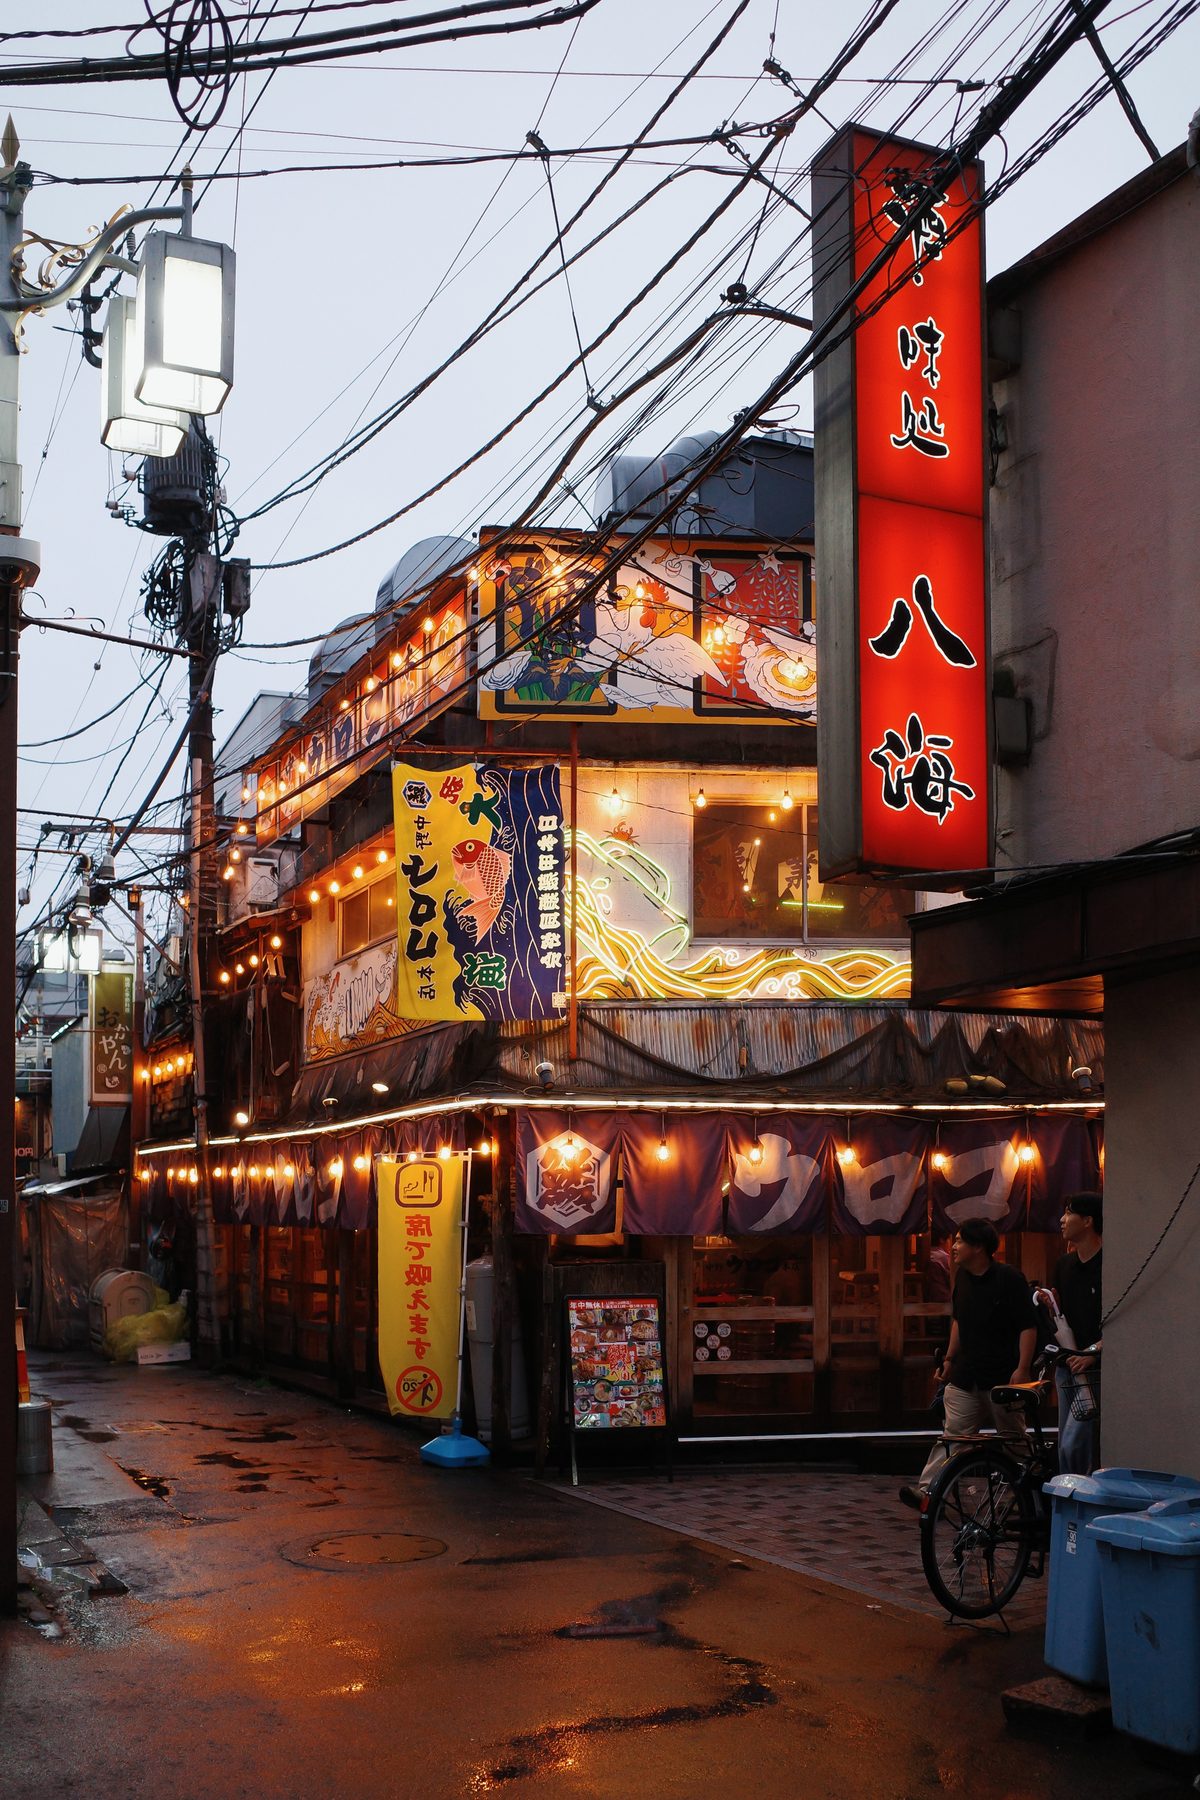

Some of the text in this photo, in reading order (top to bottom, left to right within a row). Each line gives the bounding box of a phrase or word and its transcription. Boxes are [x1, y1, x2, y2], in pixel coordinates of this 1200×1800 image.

[890, 316, 949, 458] 味処
[868, 574, 977, 825] 八海
[97, 1007, 130, 1070] おかやん
[734, 1132, 1019, 1232] ウロコ
